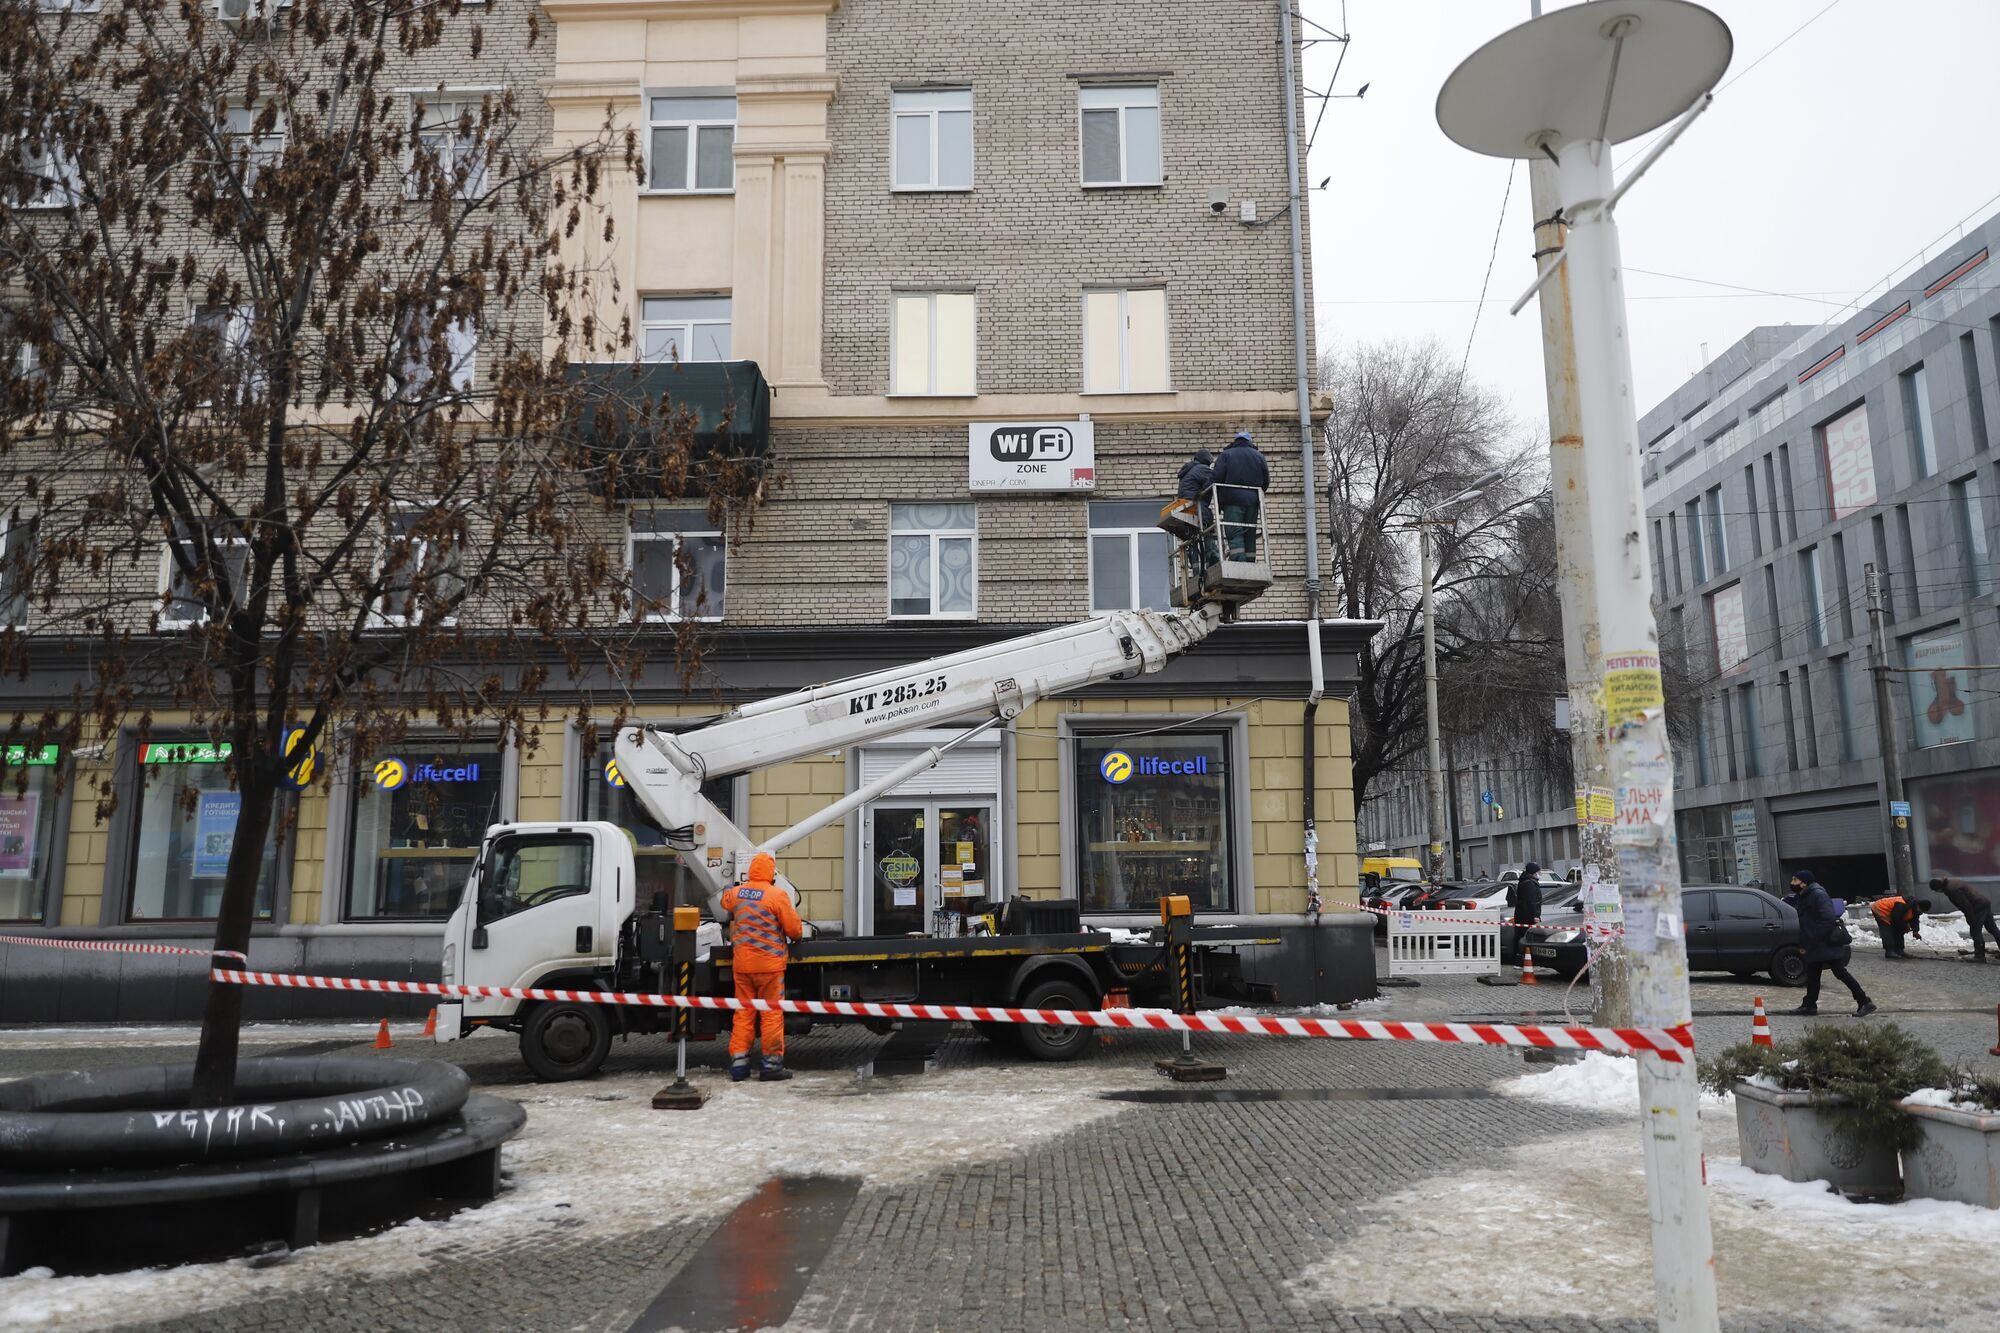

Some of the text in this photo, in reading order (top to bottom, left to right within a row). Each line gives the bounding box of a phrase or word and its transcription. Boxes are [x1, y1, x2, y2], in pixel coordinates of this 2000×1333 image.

[1016, 464, 1047, 473] ZONE
[849, 675, 947, 715] KT 285.25
[864, 699, 940, 724] www.paksan.com
[413, 763, 478, 781] lifecell
[1139, 756, 1207, 775] lifecell
[887, 862, 916, 872] eSIM
